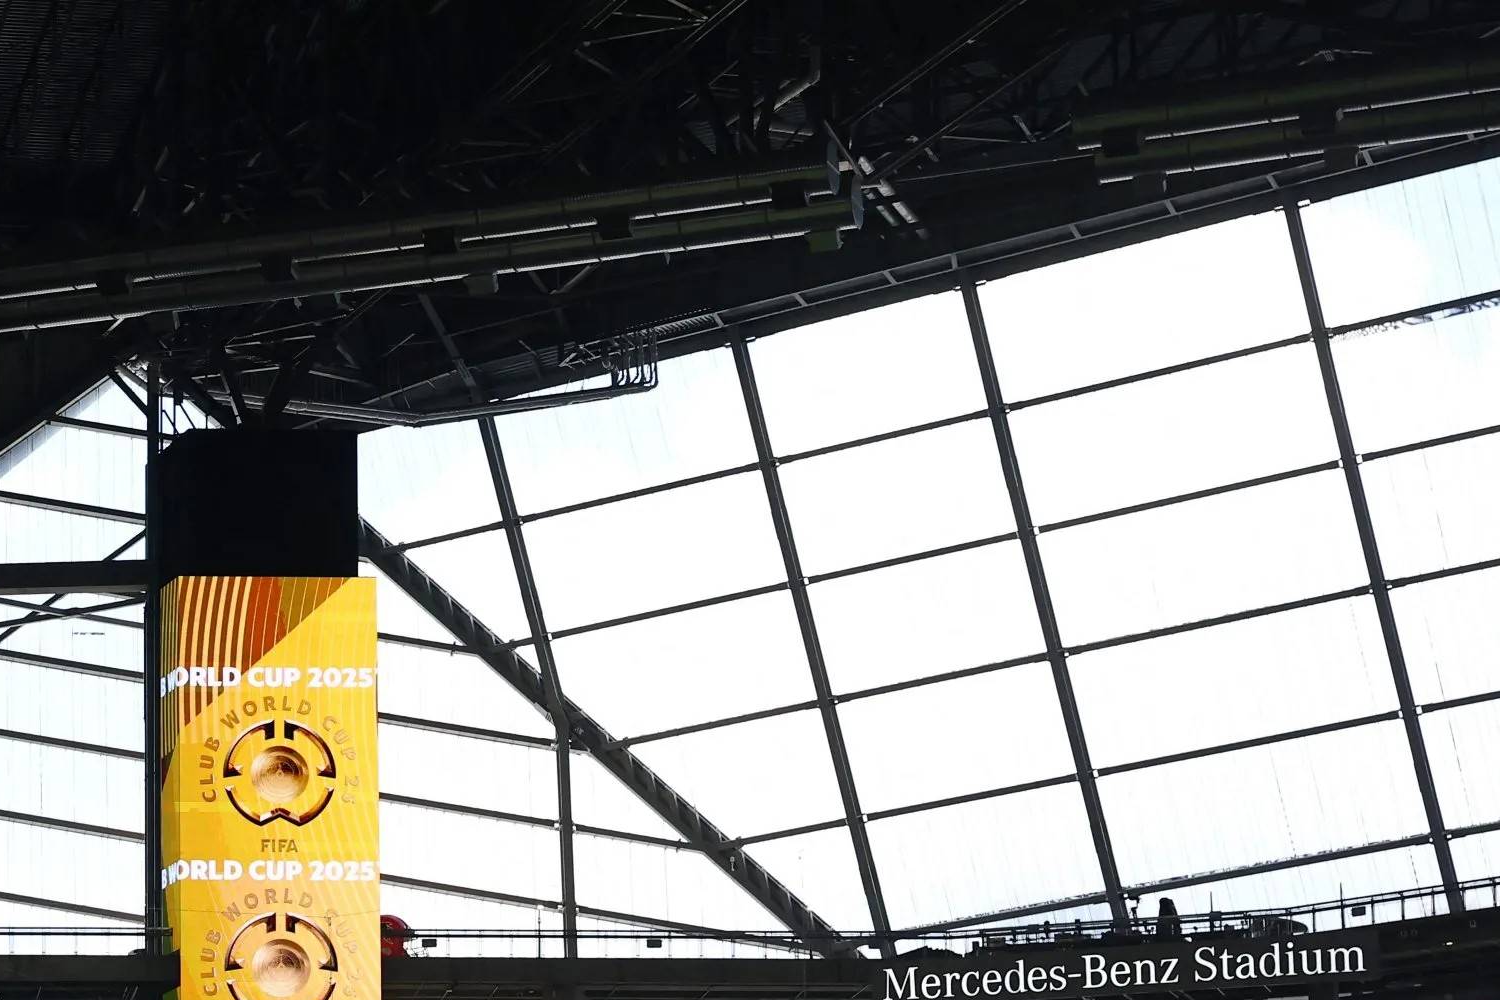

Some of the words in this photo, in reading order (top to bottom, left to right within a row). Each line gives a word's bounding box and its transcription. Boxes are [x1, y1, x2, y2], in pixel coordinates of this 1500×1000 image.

[167, 667, 242, 694] WORLD
[247, 667, 301, 687] CUP
[307, 667, 377, 687] 2025
[200, 736, 221, 803] CLUB
[220, 696, 312, 729] WORLD
[322, 715, 357, 761] CUP
[260, 839, 299, 853] FIFA
[168, 860, 243, 886] WORLD
[248, 860, 302, 880] CUP
[308, 860, 379, 881] 2025
[223, 888, 313, 922] WORLD
[1193, 941, 1367, 982] Stadium
